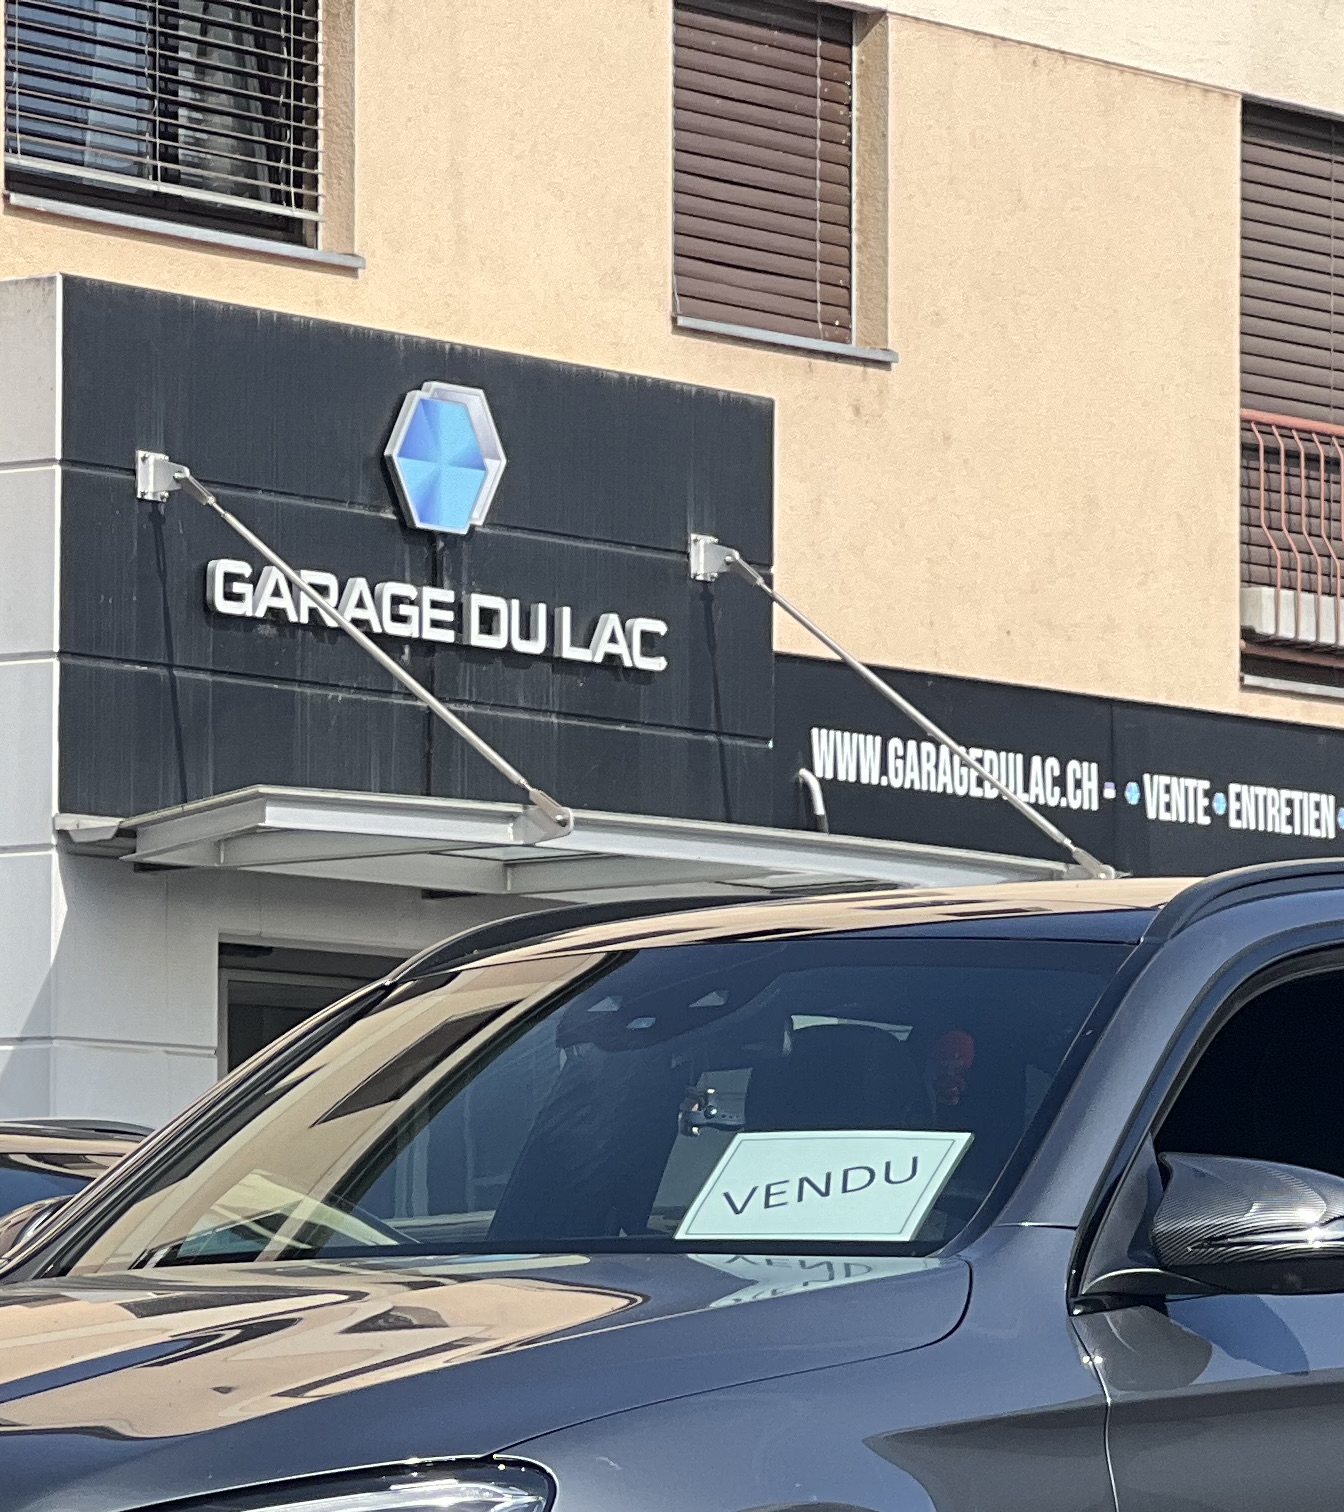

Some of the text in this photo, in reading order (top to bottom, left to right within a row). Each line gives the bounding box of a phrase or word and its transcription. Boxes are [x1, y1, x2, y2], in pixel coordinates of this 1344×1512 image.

[207, 558, 668, 672] GARAGE DU LAC
[810, 726, 1100, 812] WWW.GARAGEDULAC.CH
[1143, 773, 1211, 826] VENTE
[1228, 782, 1336, 839] ENTRETIEN
[722, 1156, 920, 1217] VENDU
